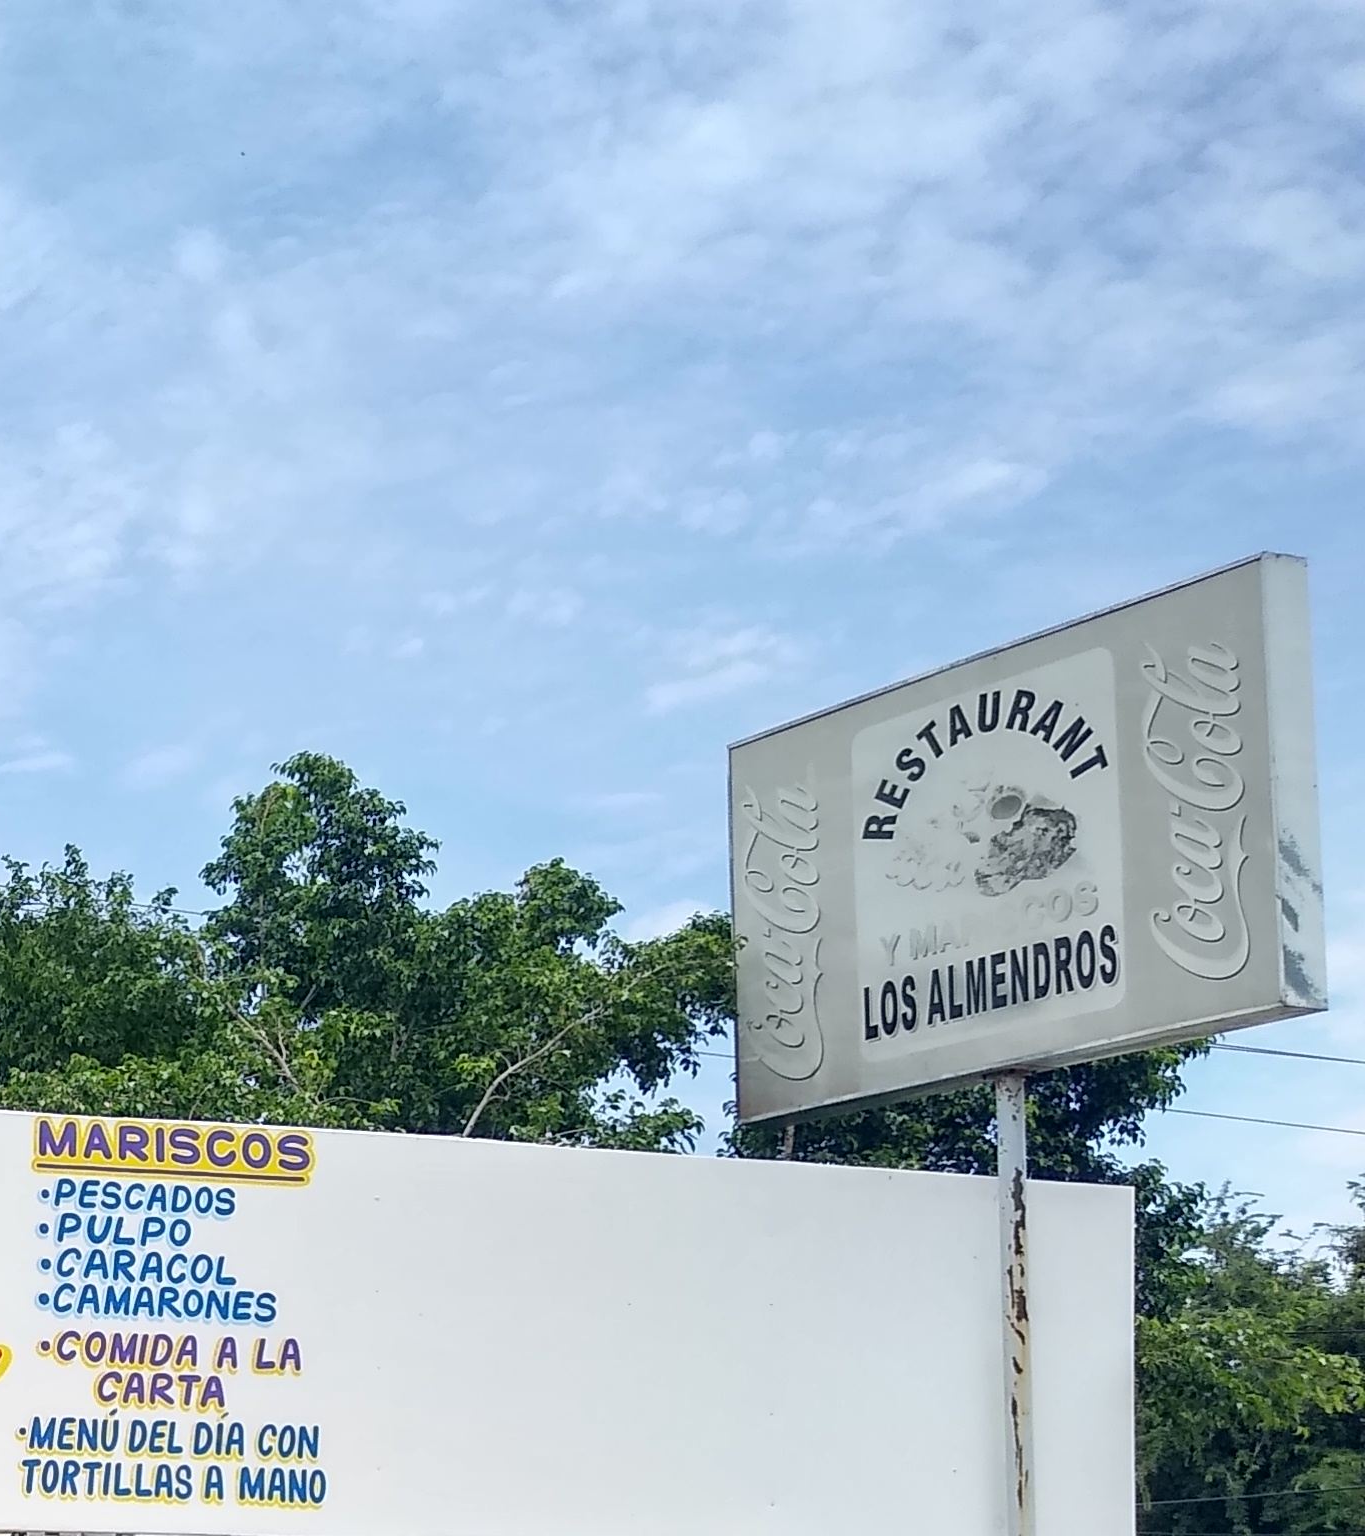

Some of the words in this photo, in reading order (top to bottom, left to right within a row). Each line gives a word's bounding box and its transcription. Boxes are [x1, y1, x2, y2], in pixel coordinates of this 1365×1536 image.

[862, 689, 1109, 841] RESTAURANT
[863, 975, 917, 1041] LOS
[927, 924, 1119, 1026] ALMENDROS
[37, 1119, 311, 1171] MARISCOS
[216, 1335, 238, 1369] A
[256, 1337, 302, 1371] LA
[96, 1371, 226, 1409] CARTA
[129, 1419, 183, 1455] DEL
[193, 1412, 245, 1457] DÍA
[258, 1424, 320, 1459] CON
[21, 1458, 193, 1500] TORTILLAS
[203, 1464, 225, 1501] A
[239, 1466, 327, 1505] MANO
